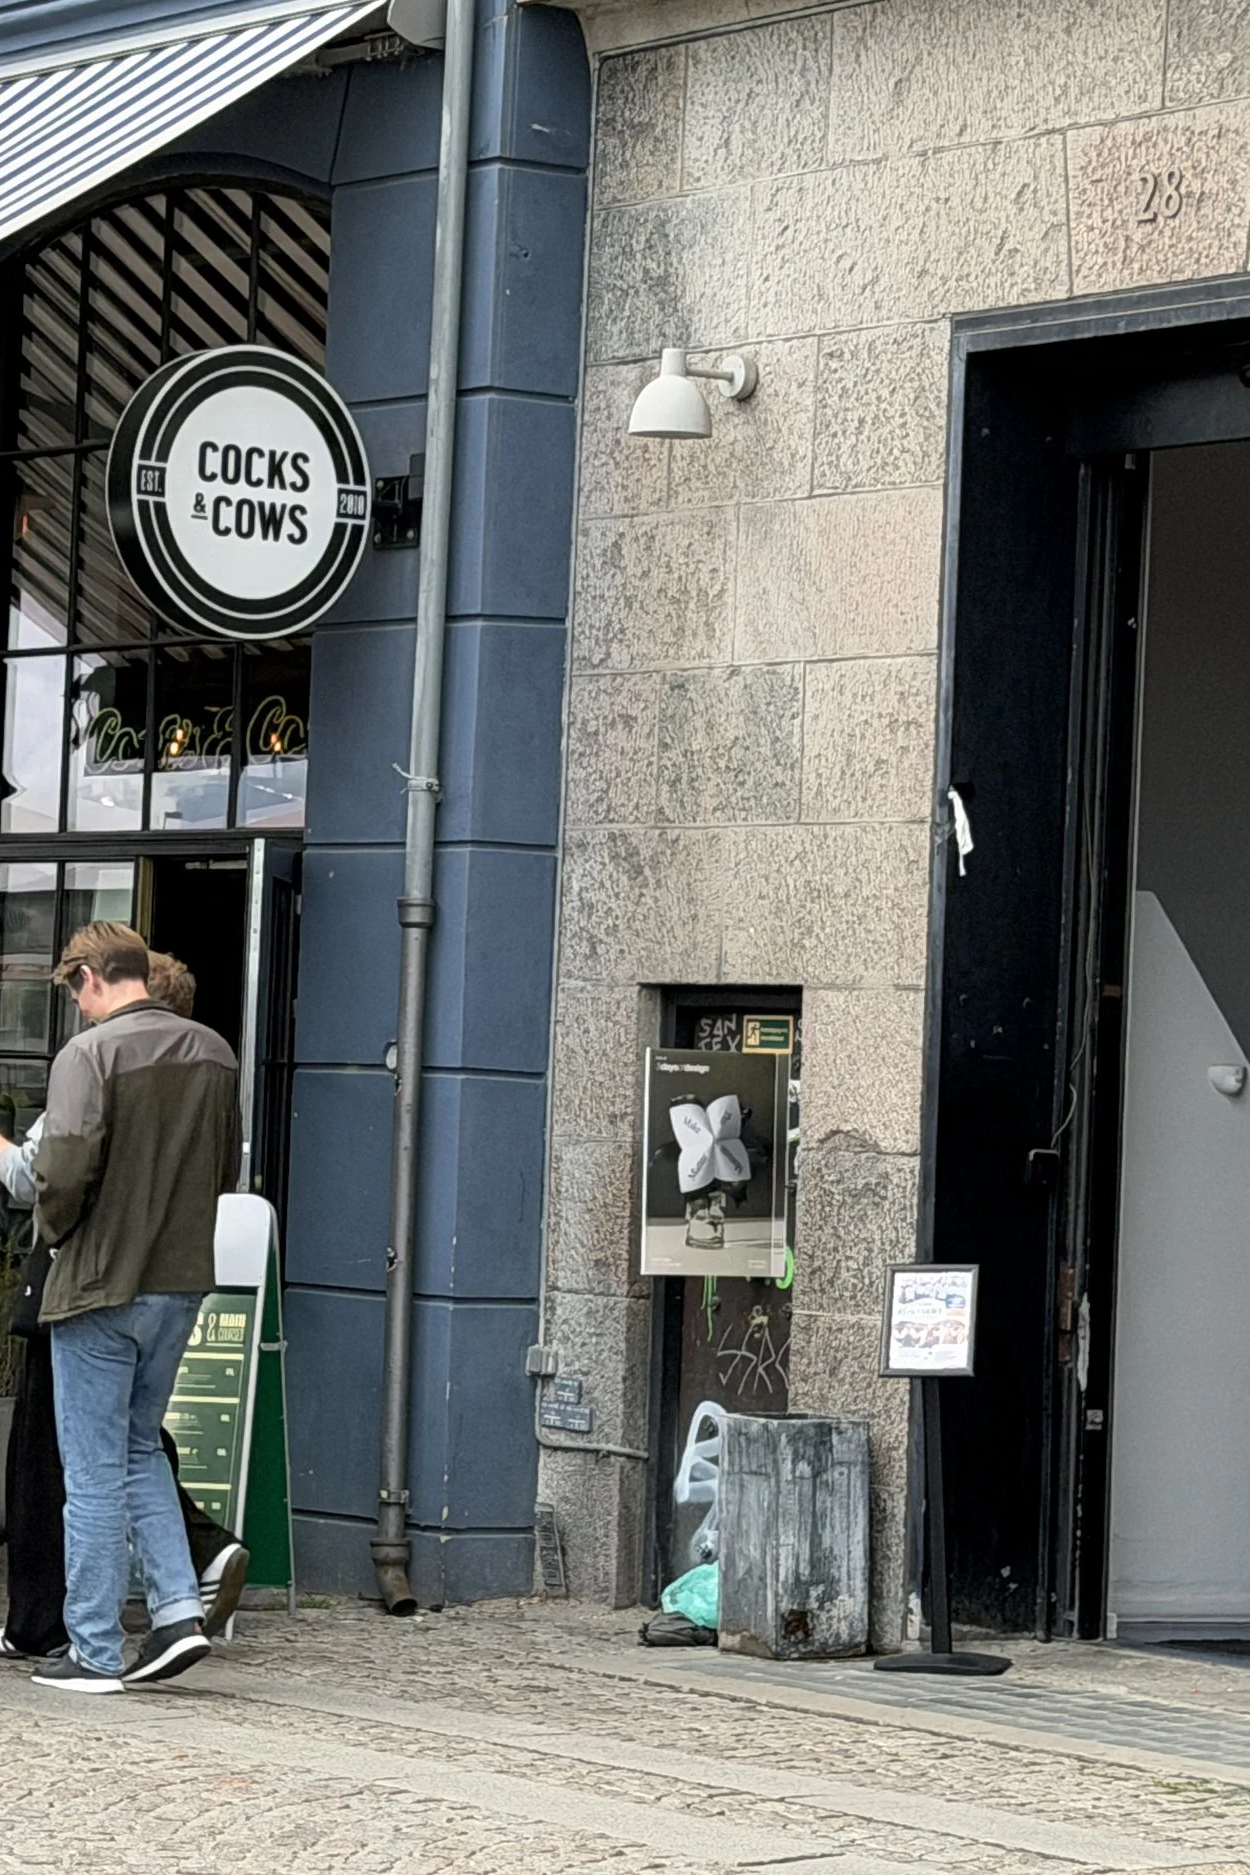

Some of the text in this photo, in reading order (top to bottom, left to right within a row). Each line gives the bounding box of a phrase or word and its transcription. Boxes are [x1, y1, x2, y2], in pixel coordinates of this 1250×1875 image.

[1136, 162, 1183, 223] 28
[140, 469, 163, 493] EST.
[197, 440, 311, 493] COCKS
[191, 492, 309, 546] & COWS
